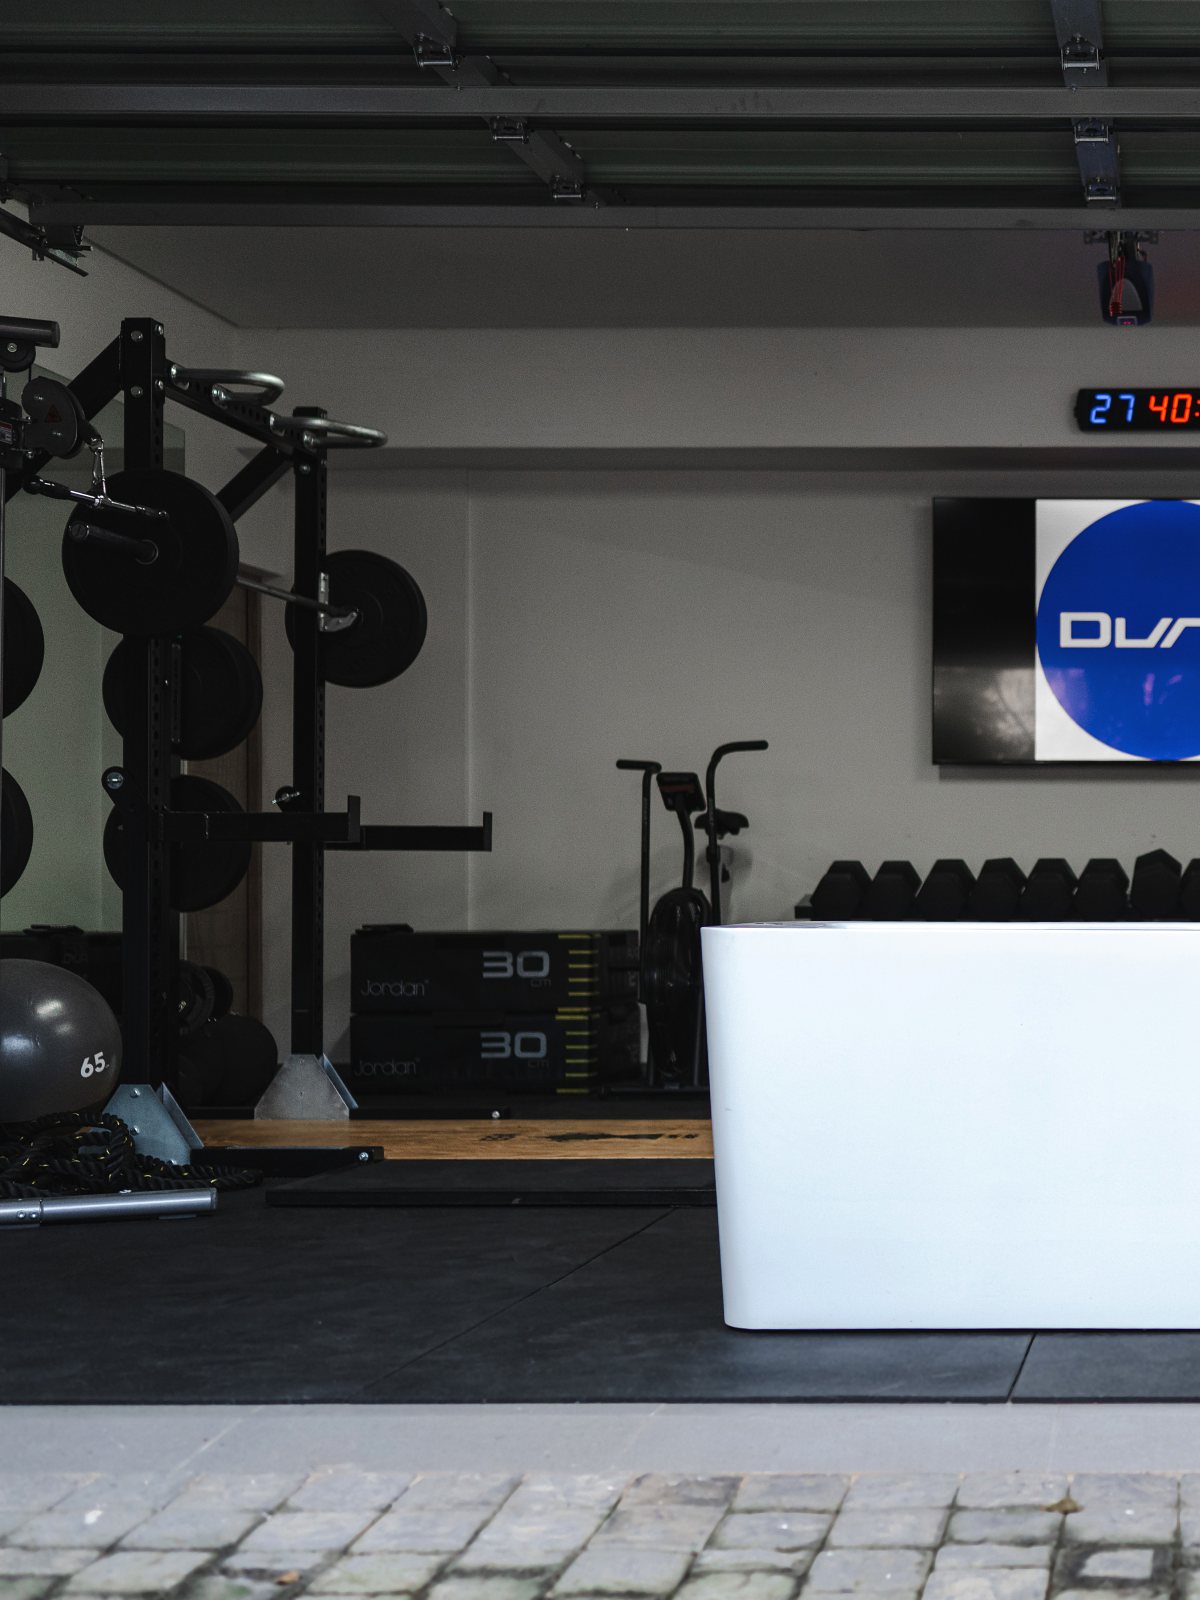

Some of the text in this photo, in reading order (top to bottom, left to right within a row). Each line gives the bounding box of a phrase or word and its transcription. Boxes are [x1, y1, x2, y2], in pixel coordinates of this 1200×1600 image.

[1089, 393, 1137, 424] 27
[481, 950, 550, 979] 30
[360, 979, 425, 997] Jordan
[479, 1030, 548, 1059] 30
[80, 1051, 106, 1078] 65
[354, 1060, 416, 1077] Jordan
